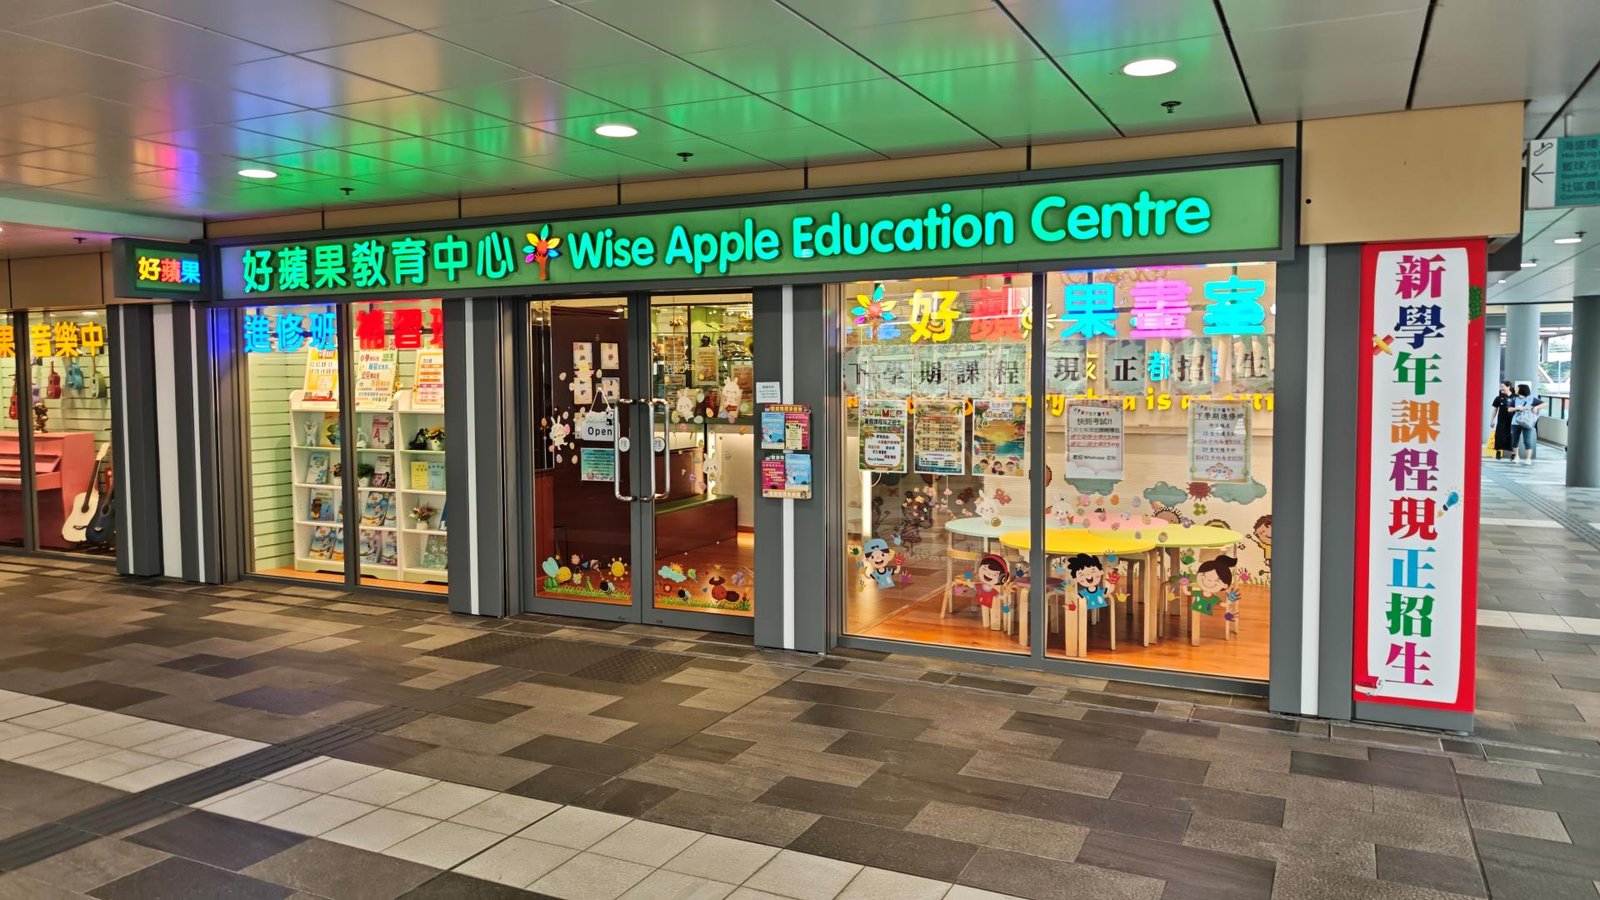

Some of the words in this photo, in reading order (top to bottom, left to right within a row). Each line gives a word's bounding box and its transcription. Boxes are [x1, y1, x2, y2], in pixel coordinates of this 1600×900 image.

[567, 228, 655, 270] Wise
[664, 217, 780, 274] Apple
[793, 203, 1014, 258] Education
[1031, 190, 1211, 242] Centre
[138, 256, 201, 284] 好蘋果
[243, 311, 337, 353] 進修班
[1146, 388, 1172, 411] is
[587, 426, 613, 436] Open
[1385, 254, 1446, 687] 新學年課程現正招生
